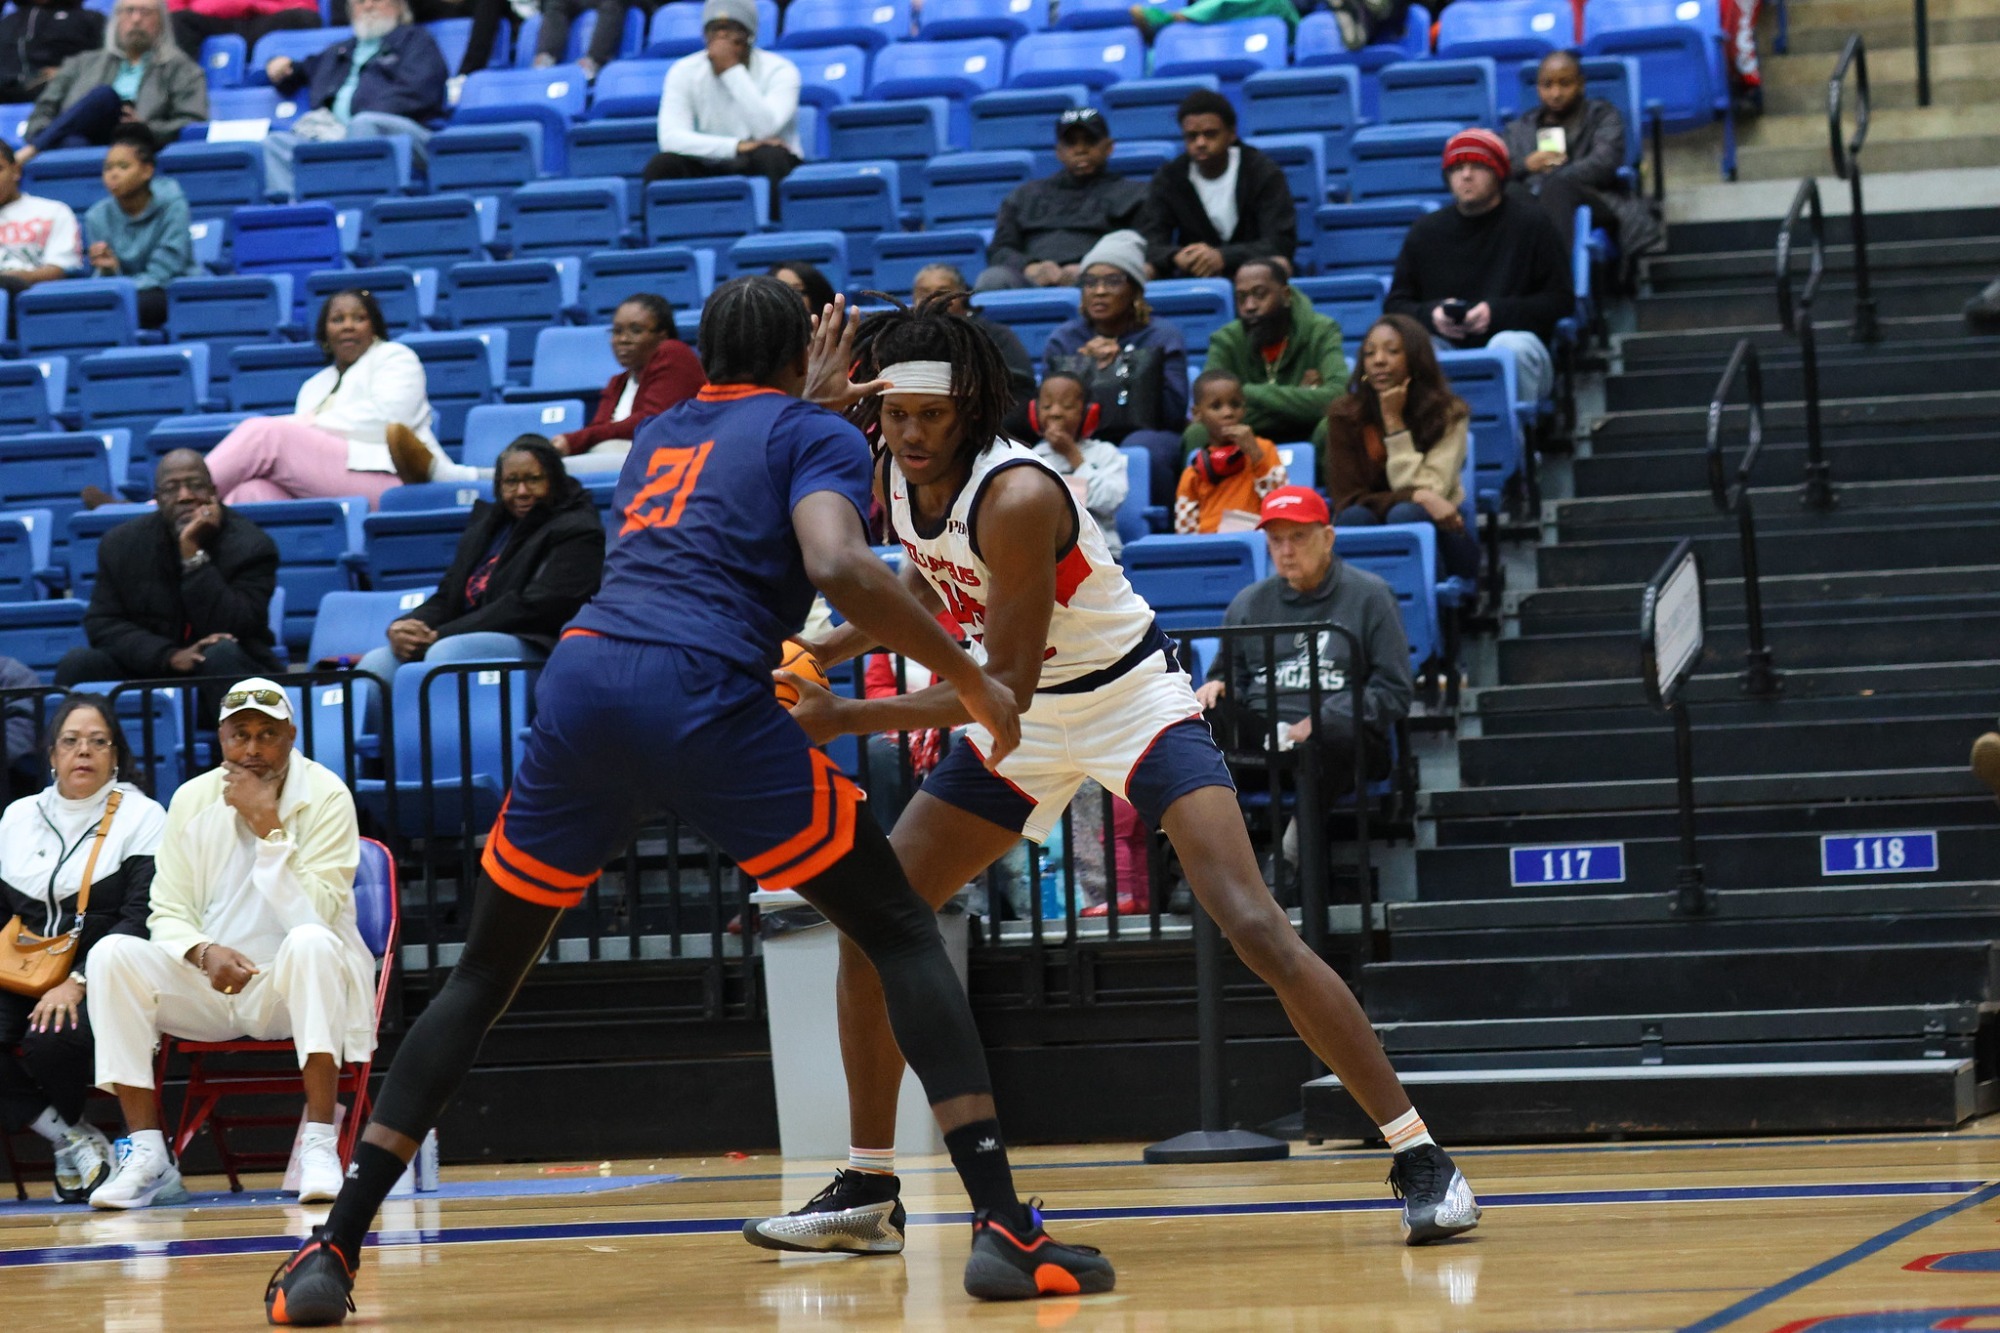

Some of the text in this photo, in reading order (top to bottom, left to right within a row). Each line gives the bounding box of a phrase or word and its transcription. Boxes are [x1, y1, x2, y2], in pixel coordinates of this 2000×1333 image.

[619, 439, 716, 538] 21
[1541, 850, 1593, 880] 117
[1853, 837, 1906, 868] 118
